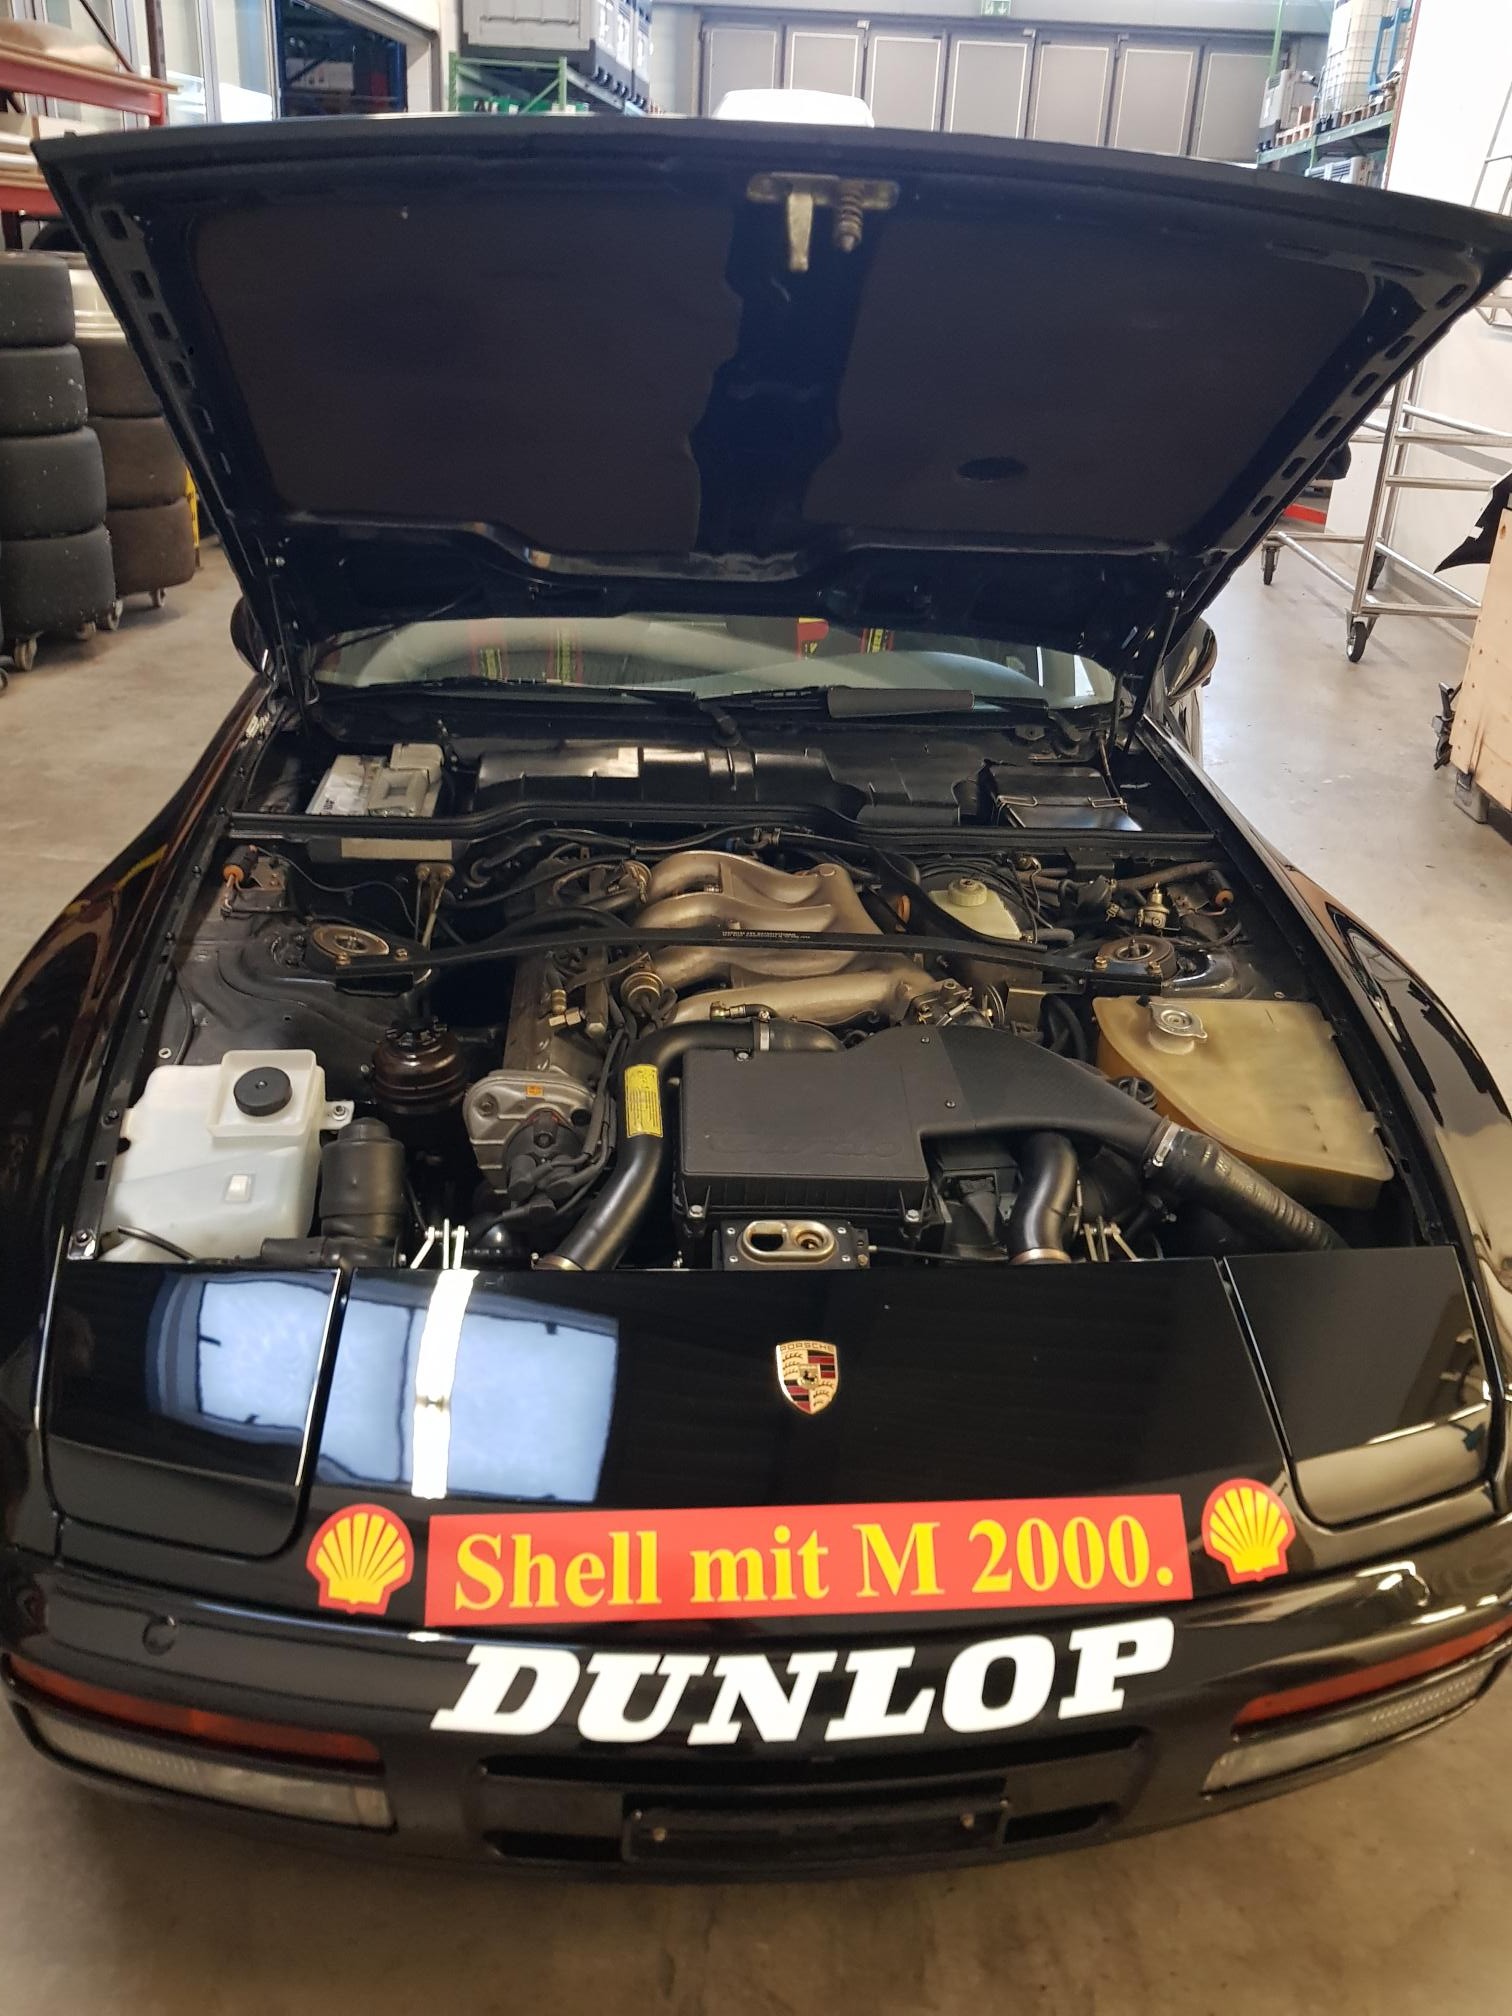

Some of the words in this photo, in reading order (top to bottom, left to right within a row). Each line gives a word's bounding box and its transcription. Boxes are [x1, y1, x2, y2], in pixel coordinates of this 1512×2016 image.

[780, 1341, 835, 1352] PORSCHE
[455, 1530, 662, 1611] Shell
[689, 1524, 830, 1604] mit
[852, 1521, 946, 1599] M
[967, 1514, 1174, 1594] 2000.
[430, 1616, 1175, 1746] DUNLOP
